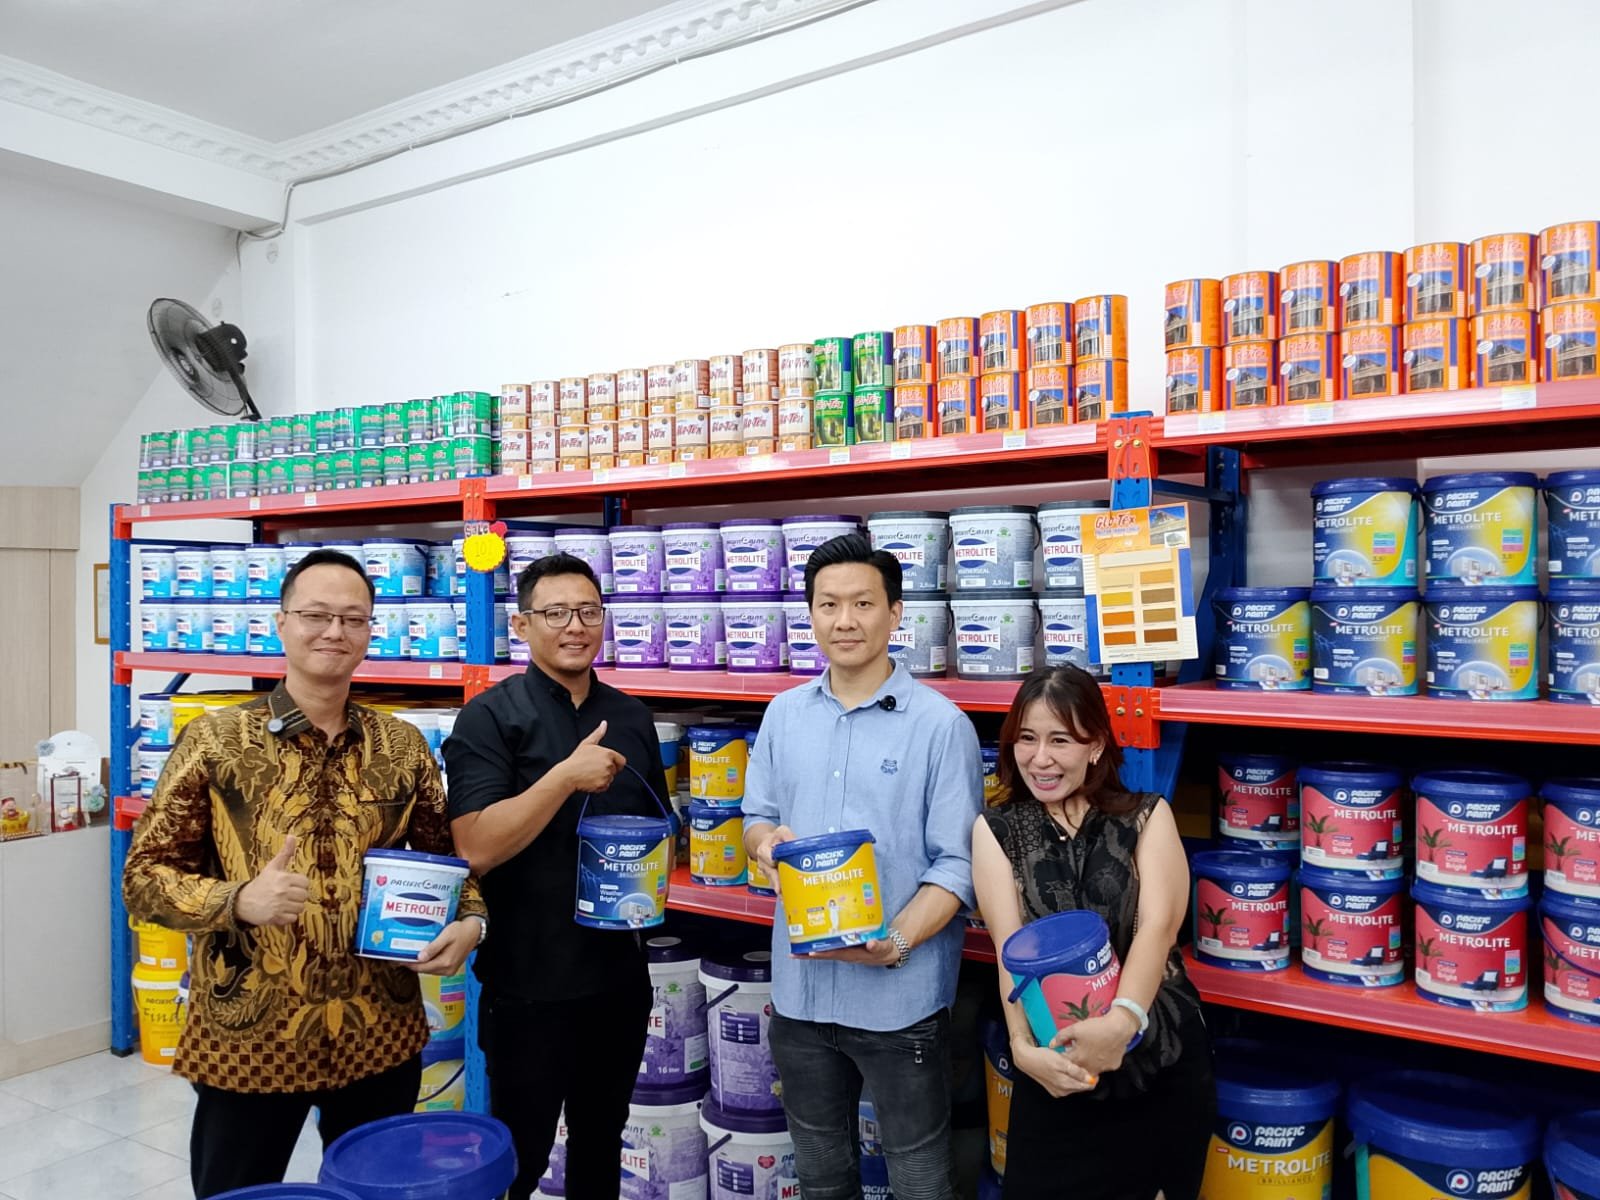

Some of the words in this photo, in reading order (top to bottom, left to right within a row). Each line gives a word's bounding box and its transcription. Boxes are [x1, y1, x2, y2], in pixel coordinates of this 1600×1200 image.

[1315, 517, 1373, 529] METROLITE
[1433, 512, 1502, 525] METROLITE
[955, 548, 995, 557] METROLITE
[1231, 624, 1294, 634] METROLITE
[1335, 624, 1403, 635] METROLITE
[1438, 626, 1509, 637] METROLITE
[957, 633, 999, 643] METROLITE
[1233, 784, 1292, 797] METROLITE
[1334, 808, 1397, 821] METROLITE
[1448, 822, 1518, 836] METROLITE
[814, 850, 844, 861] PACIFIC
[604, 862, 659, 873] METROLITE
[816, 858, 839, 868] PAINT
[803, 868, 864, 887] METROLITE
[385, 901, 447, 917] METROLITE
[1231, 901, 1287, 913] METROLITE
[1329, 913, 1394, 926] METROLITE
[1439, 932, 1510, 948] METROLITE
[658, 1066, 668, 1074] 16
[1255, 1126, 1305, 1137] PACIFIC
[1255, 1137, 1295, 1148] PAINT
[1228, 1150, 1331, 1176] METROLITE
[1477, 1166, 1523, 1182] PACIFIC
[1477, 1180, 1515, 1193] PAINT
